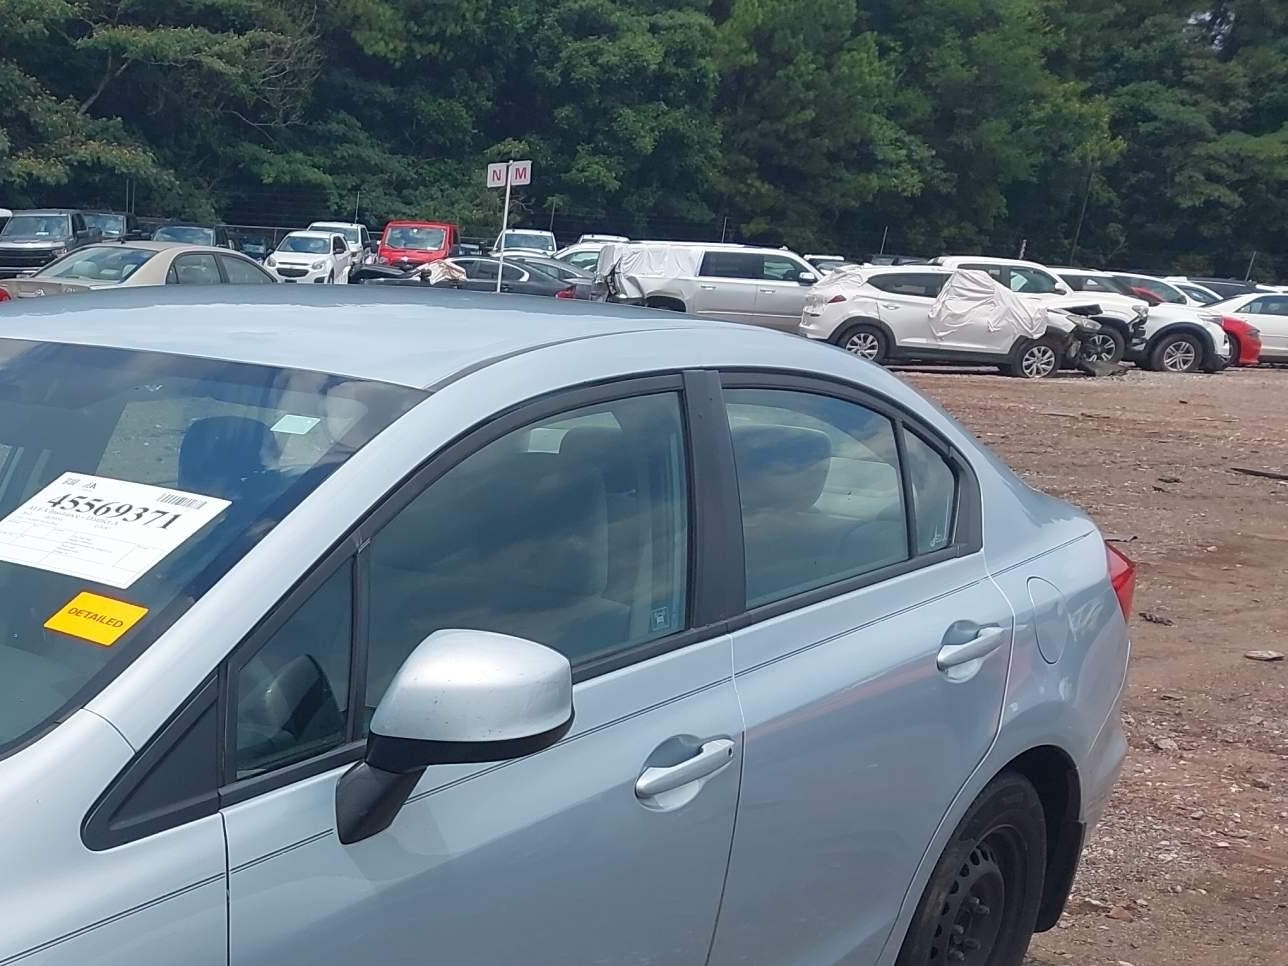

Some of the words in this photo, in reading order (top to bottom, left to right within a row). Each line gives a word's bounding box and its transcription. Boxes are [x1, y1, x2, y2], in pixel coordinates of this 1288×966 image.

[492, 169, 502, 182] N
[514, 167, 527, 180] M
[48, 493, 183, 529] 45569371
[67, 607, 124, 628] DETAILED
